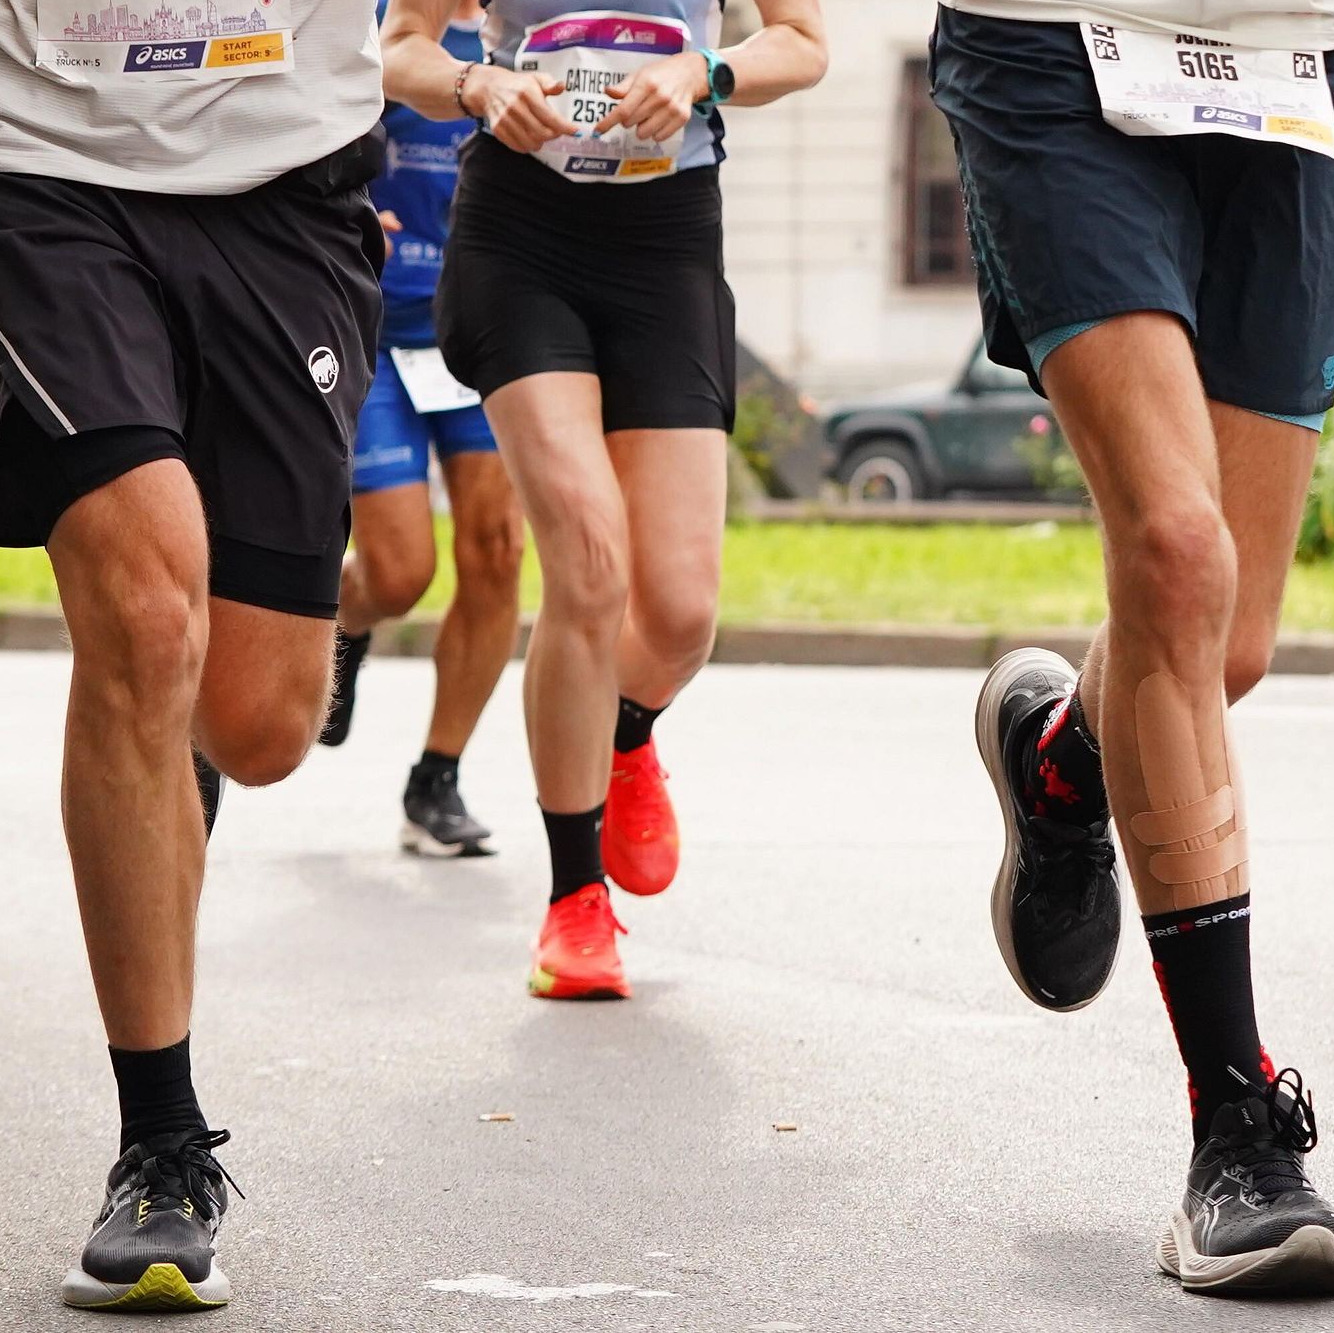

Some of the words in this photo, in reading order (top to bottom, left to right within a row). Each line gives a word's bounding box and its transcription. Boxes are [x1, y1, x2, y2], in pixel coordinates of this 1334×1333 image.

[223, 41, 252, 51] START
[152, 46, 187, 62] asics
[223, 50, 263, 62] SECTOR:
[55, 58, 81, 66] TRUCK
[95, 58, 101, 67] 5
[1177, 50, 1239, 81] 5165
[1216, 110, 1248, 123] asics
